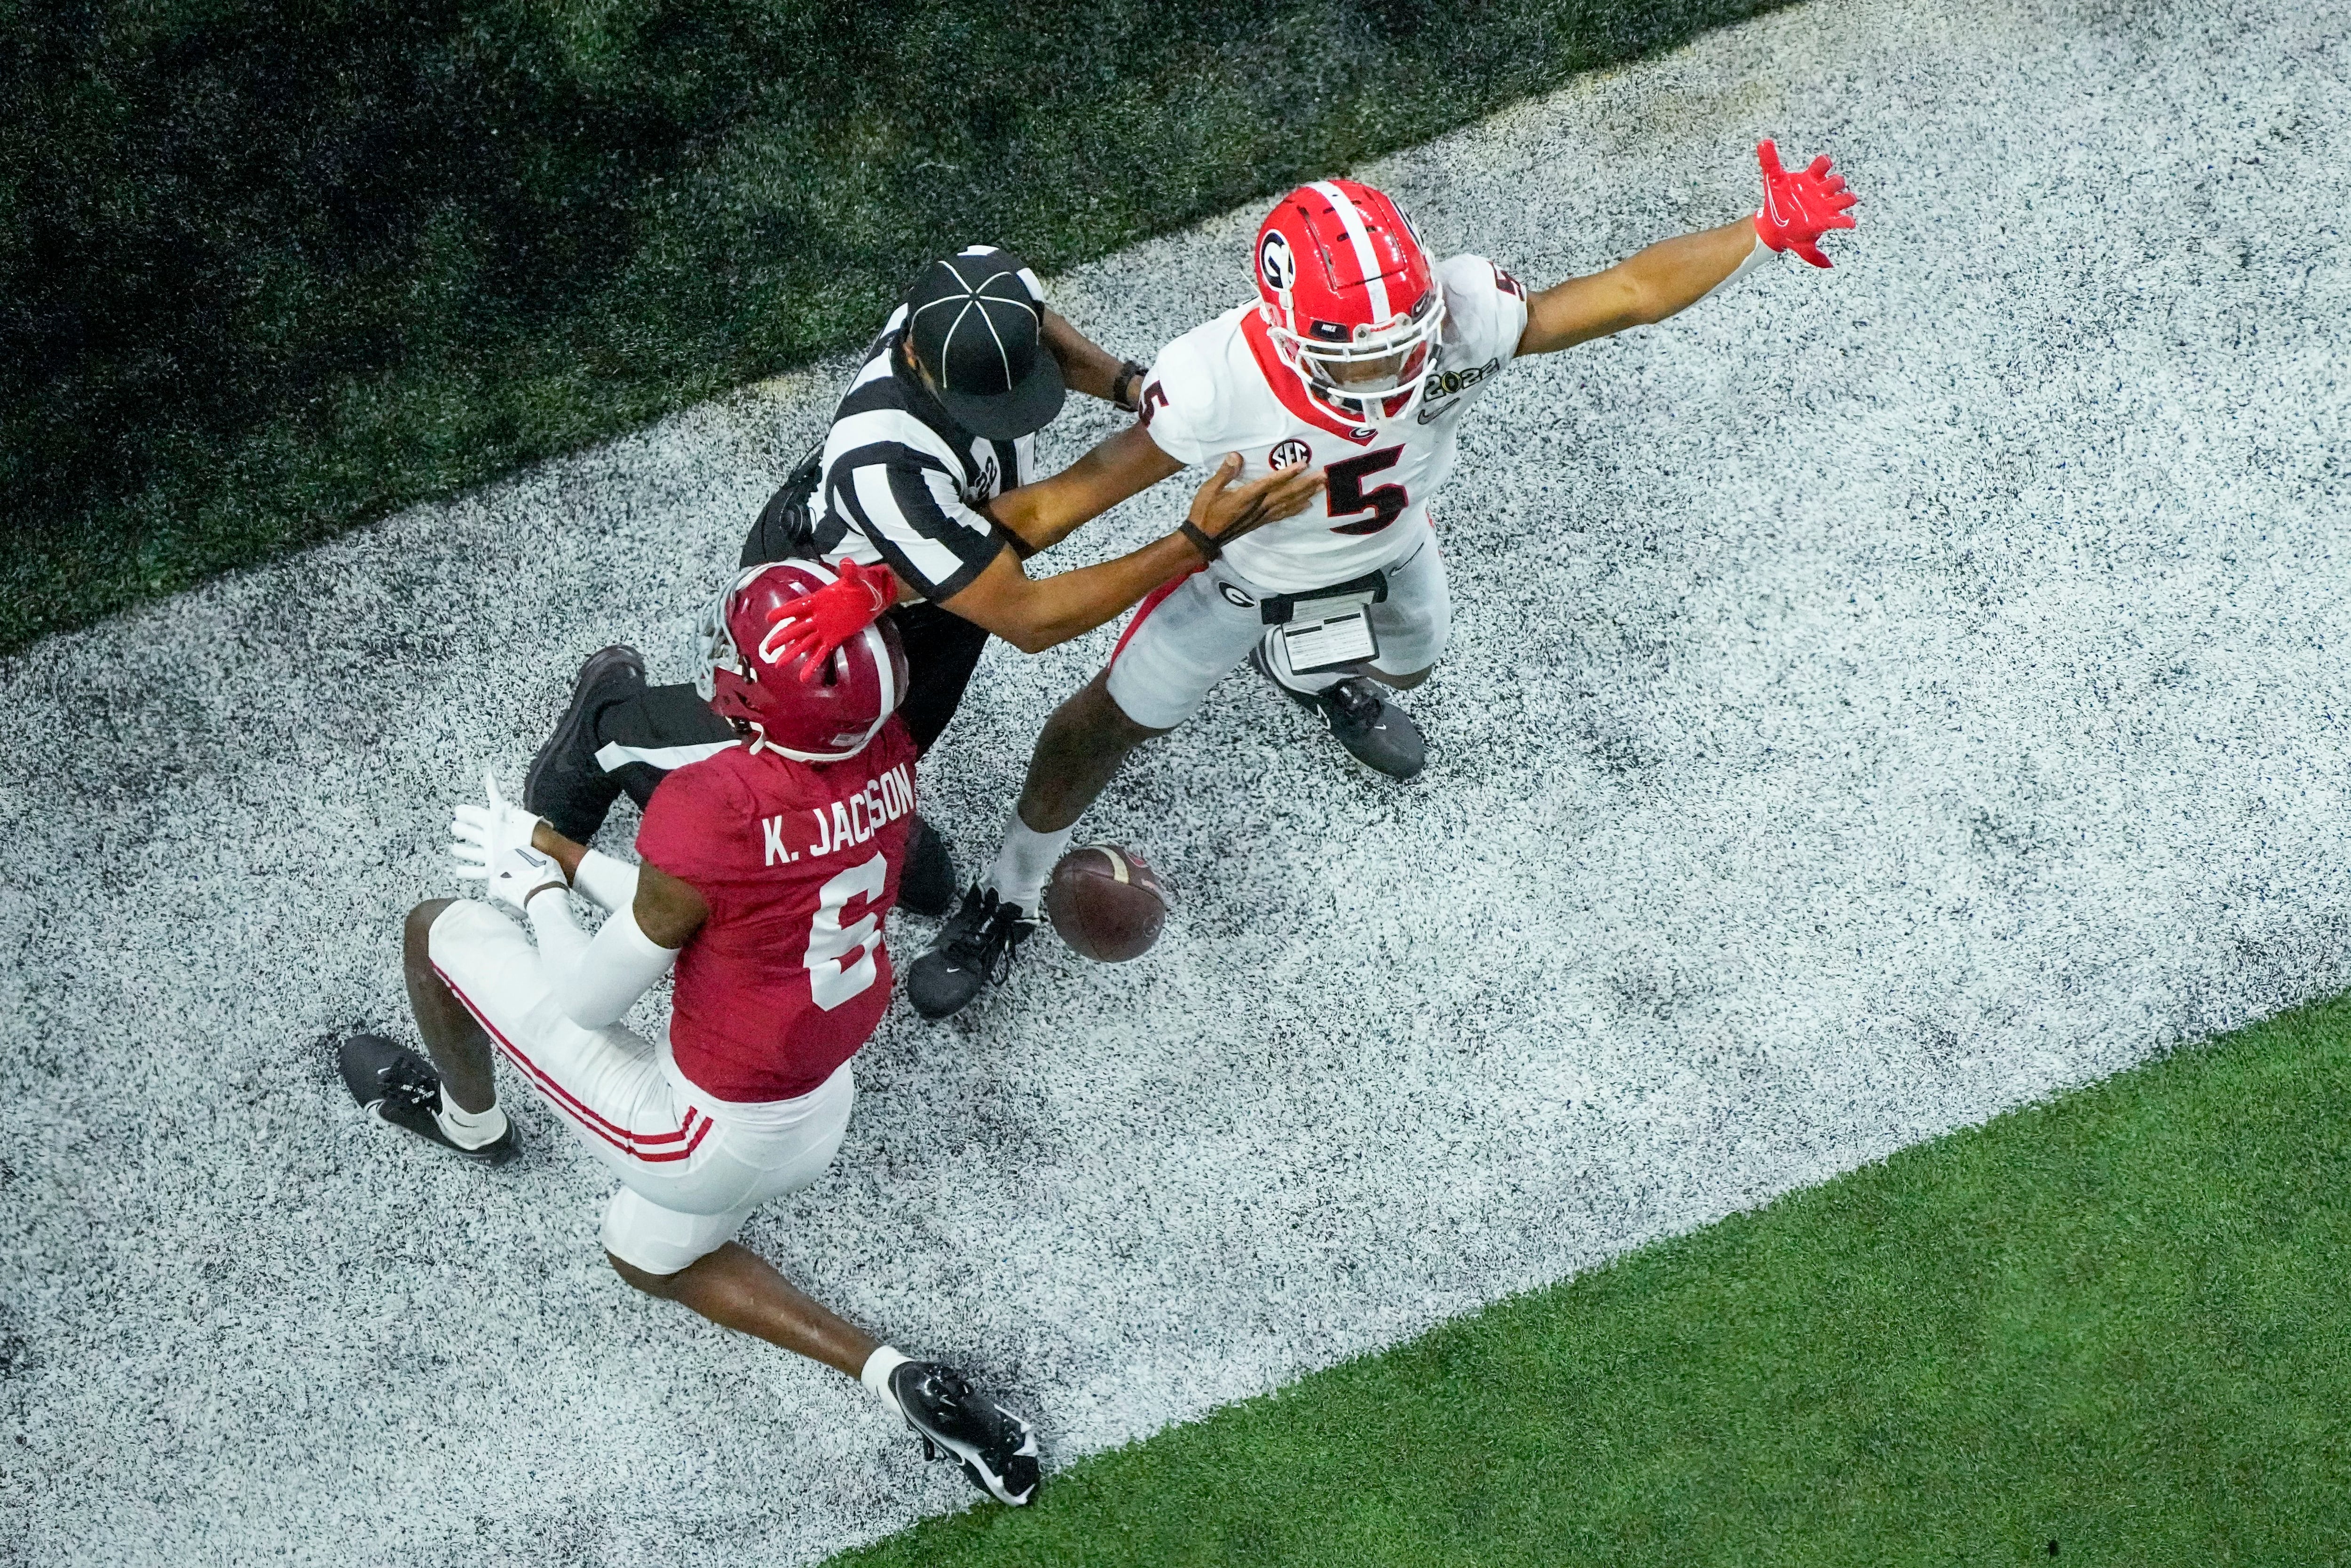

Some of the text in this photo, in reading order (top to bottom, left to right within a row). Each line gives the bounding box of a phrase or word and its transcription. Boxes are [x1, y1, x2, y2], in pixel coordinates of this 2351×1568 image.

[1321, 324, 1337, 332] NIKE
[1138, 379, 1170, 428] 5
[1272, 441, 1307, 470] SEC
[1324, 443, 1409, 535] 5
[1219, 581, 1255, 608] G
[762, 815, 799, 867] K.
[803, 850, 888, 1011] 6
